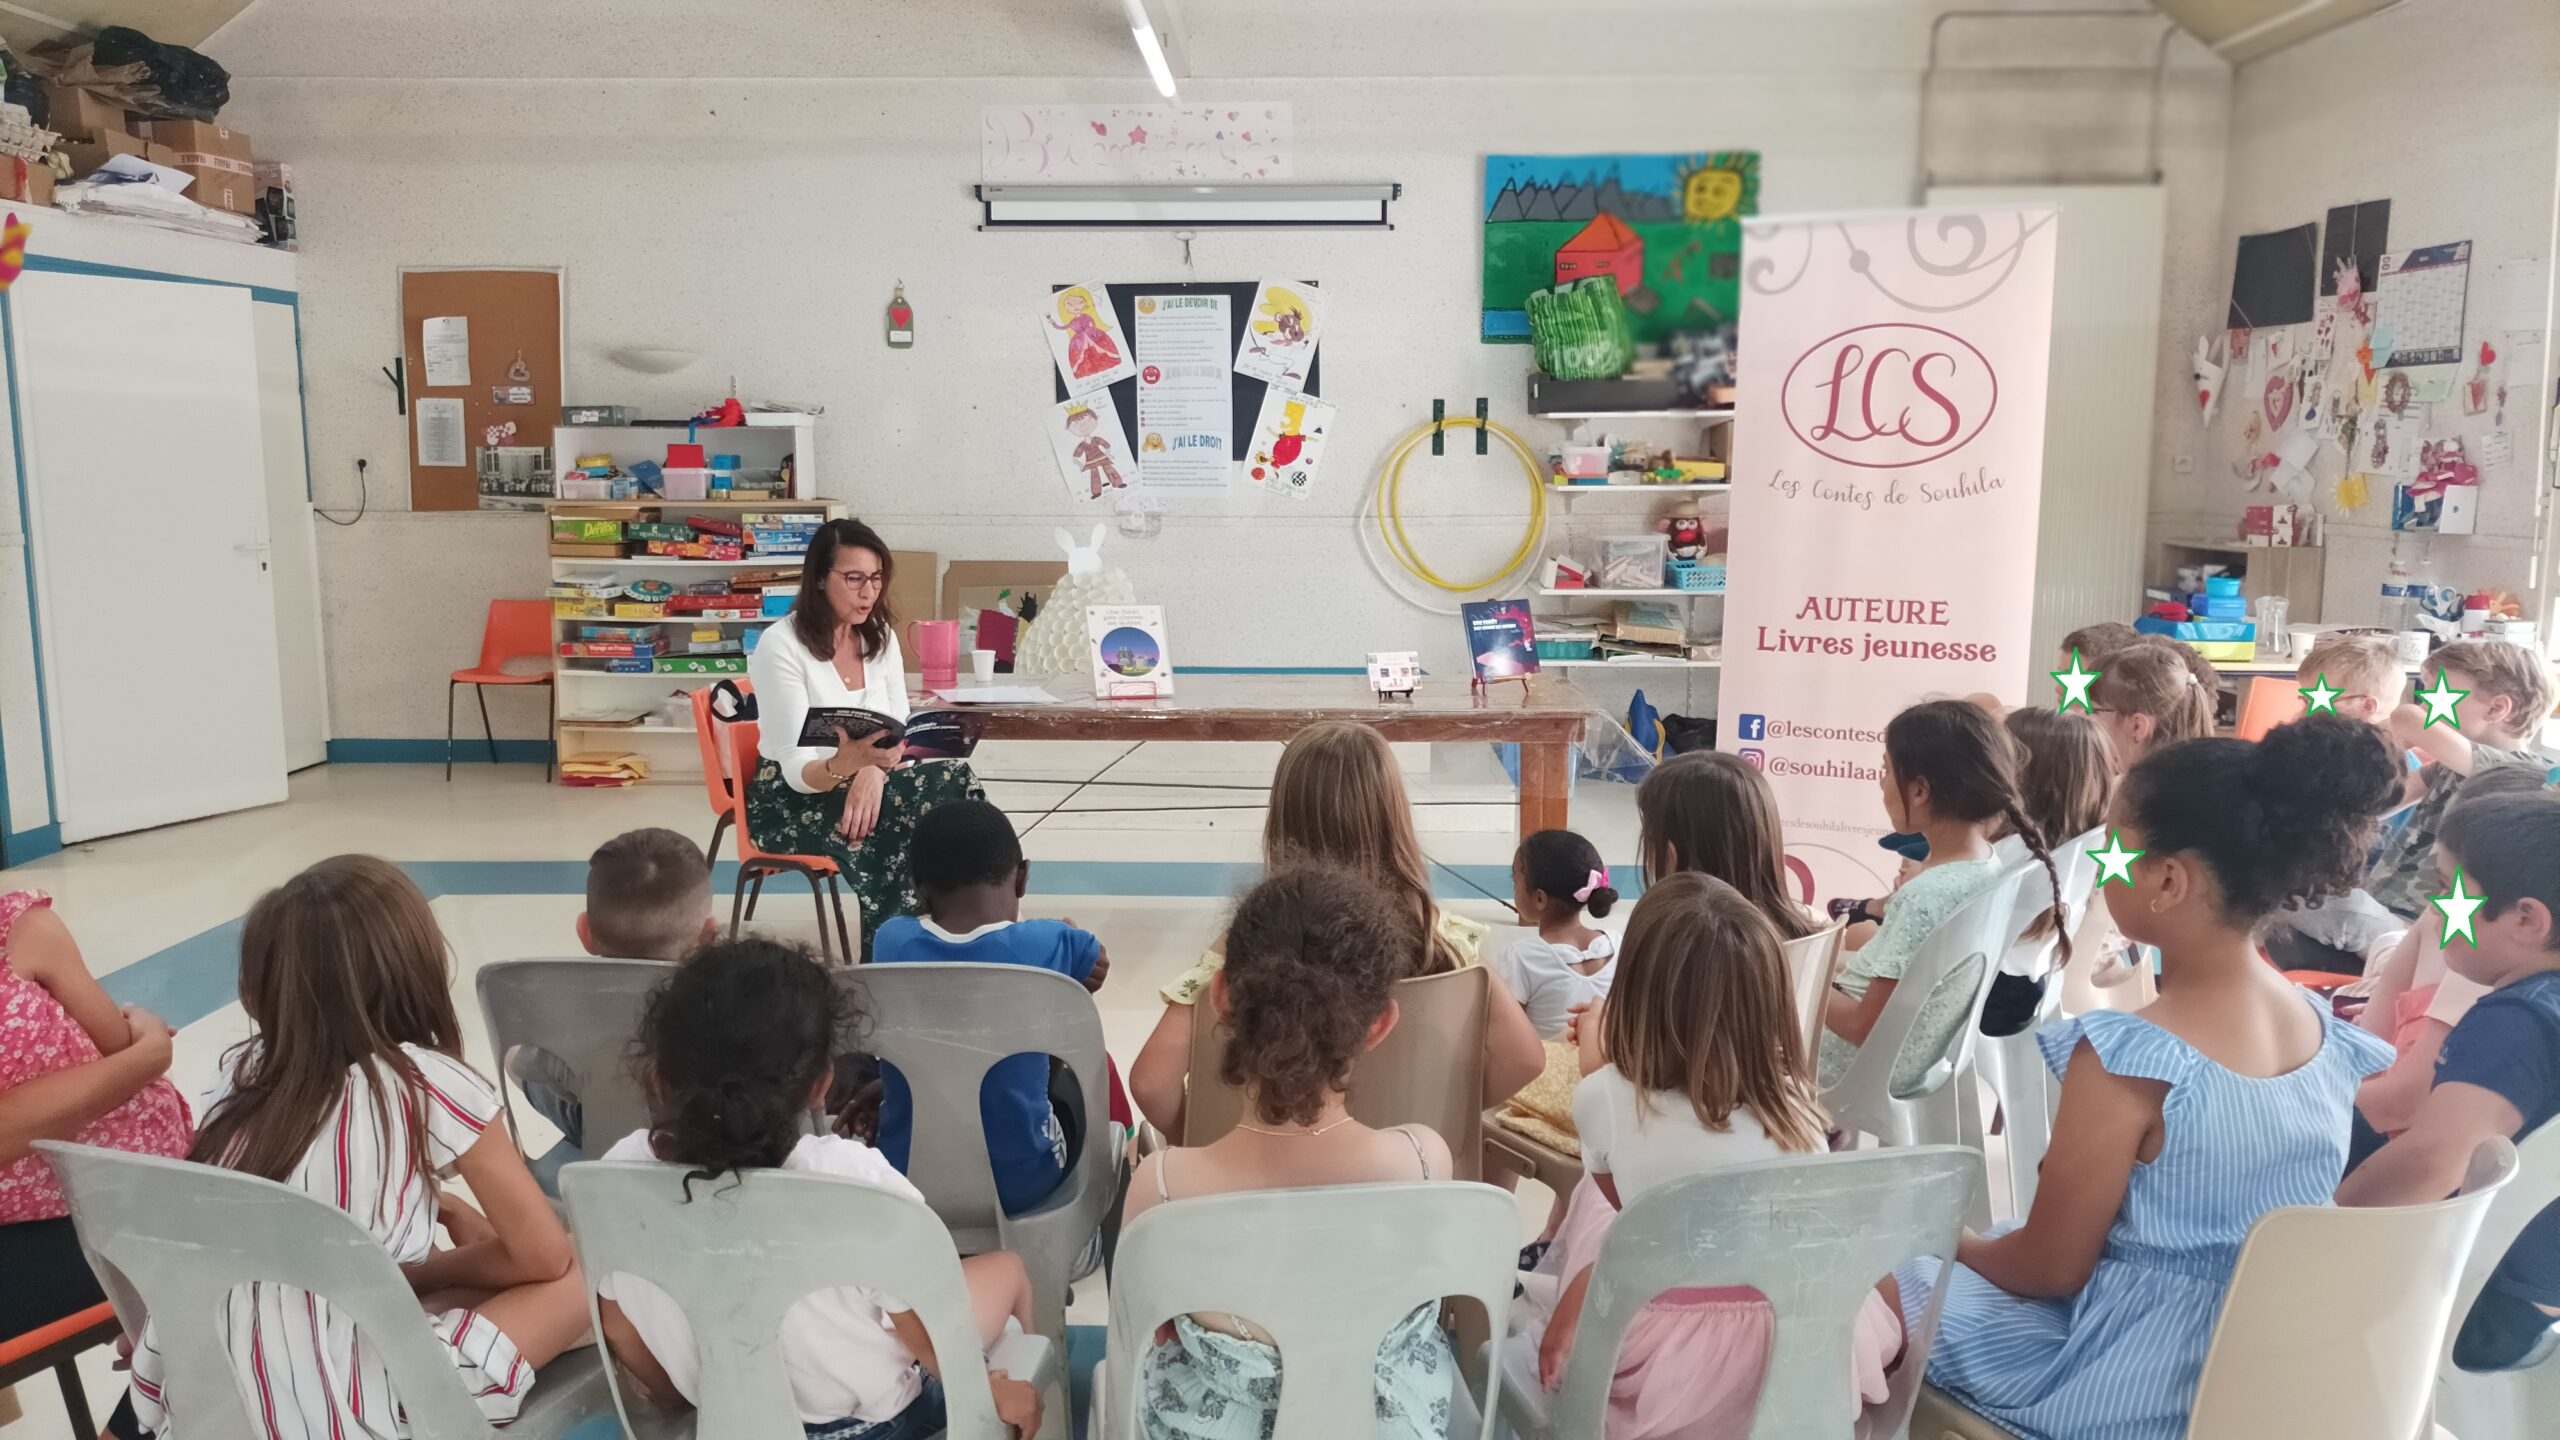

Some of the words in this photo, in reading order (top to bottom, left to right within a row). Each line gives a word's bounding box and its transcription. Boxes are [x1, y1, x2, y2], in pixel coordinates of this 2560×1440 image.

[1162, 298, 1174, 311] J'AI
[1175, 297, 1184, 309] LE
[1185, 297, 1209, 309] DEVOIR
[1210, 299, 1218, 311] DE
[1811, 344, 1961, 447] LCS
[1172, 436, 1186, 451] J'AI
[1188, 435, 1198, 447] LE
[1200, 434, 1223, 451] DROIT
[1768, 469, 1801, 500] Les
[1812, 479, 1875, 511] Contes
[1884, 479, 1909, 505] de
[1920, 466, 2005, 504] Souhila
[1796, 596, 1950, 626] AUTEURE
[1757, 626, 1854, 655] Livres
[1861, 632, 1997, 662] jeunesse
